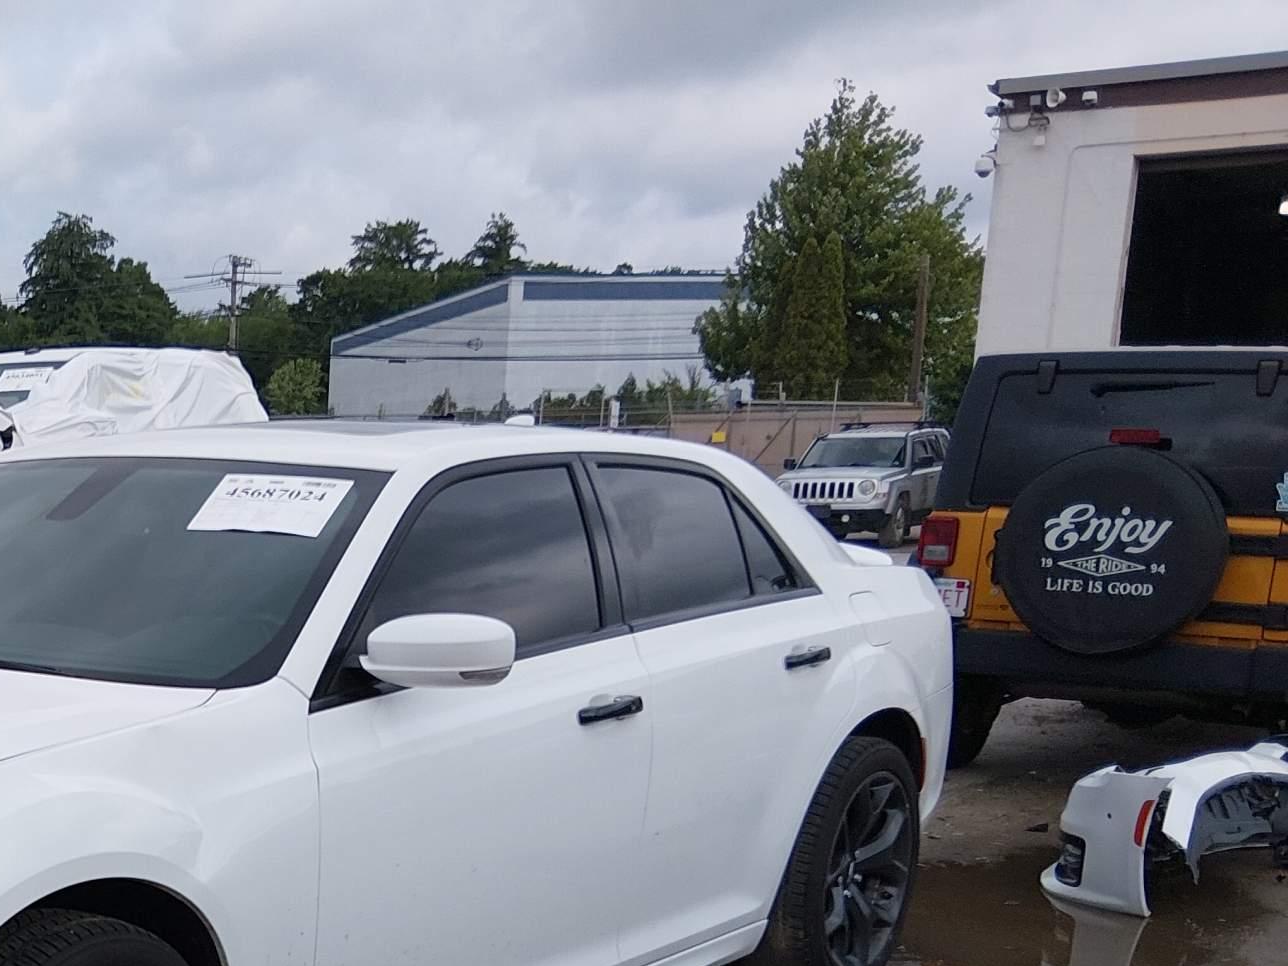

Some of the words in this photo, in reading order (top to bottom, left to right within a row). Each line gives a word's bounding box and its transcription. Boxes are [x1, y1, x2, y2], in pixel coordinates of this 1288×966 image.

[226, 487, 327, 502] 45687024
[1044, 503, 1173, 554] Enjoy
[1040, 557, 1053, 568] 19
[1076, 558, 1097, 572] THE
[1098, 558, 1129, 574] RIDE
[1150, 563, 1166, 574] 94
[1045, 577, 1083, 592] LIFE
[1087, 580, 1103, 593] IS
[1107, 582, 1154, 596] GOOD
[937, 588, 964, 608] ET
